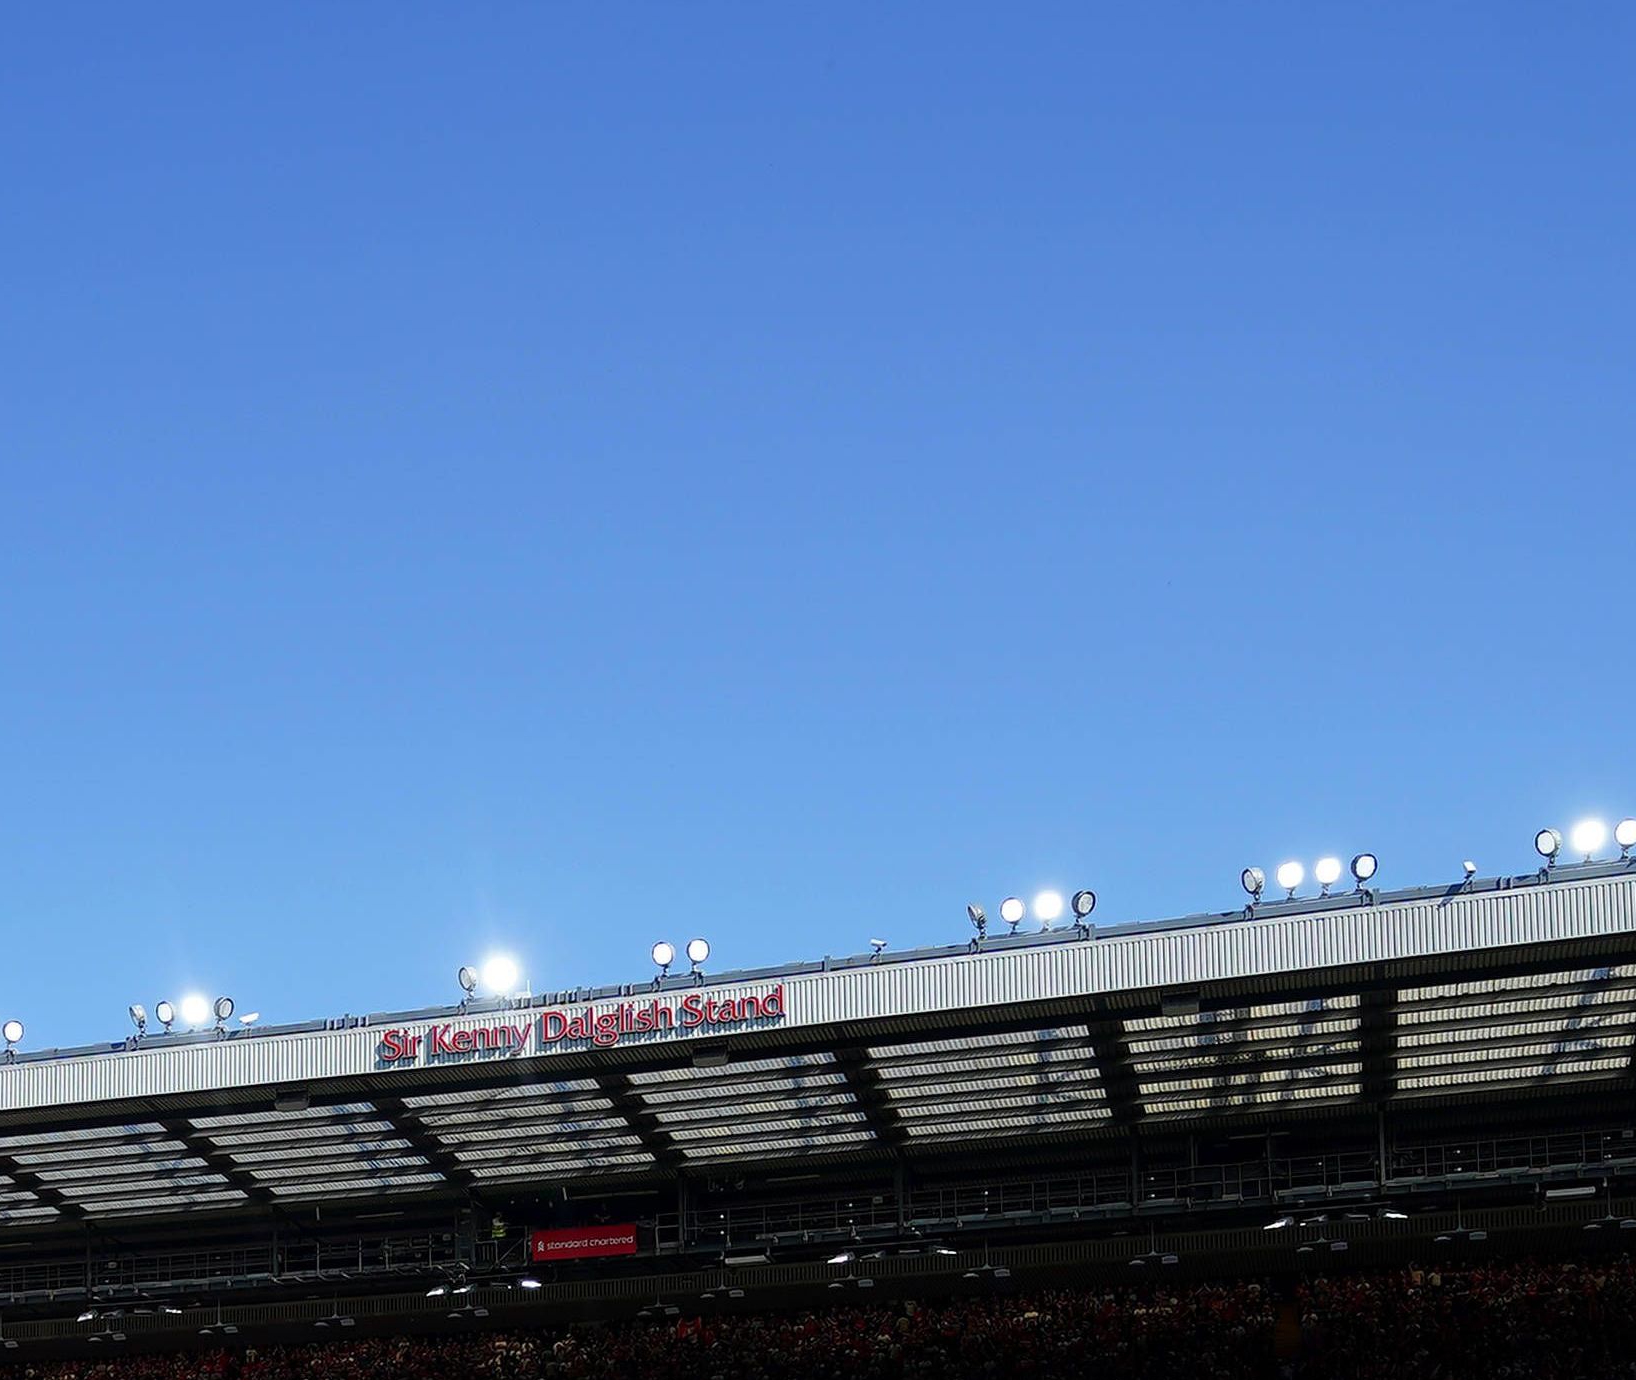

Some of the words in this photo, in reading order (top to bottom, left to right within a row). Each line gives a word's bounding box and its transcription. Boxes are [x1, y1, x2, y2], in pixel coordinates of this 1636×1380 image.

[381, 1028, 422, 1061] Sir
[431, 1022, 532, 1056] Kenny
[542, 1001, 674, 1047] Dalglish
[683, 985, 785, 1026] Stand
[547, 1239, 588, 1251] standard
[589, 1235, 634, 1247] chartered
